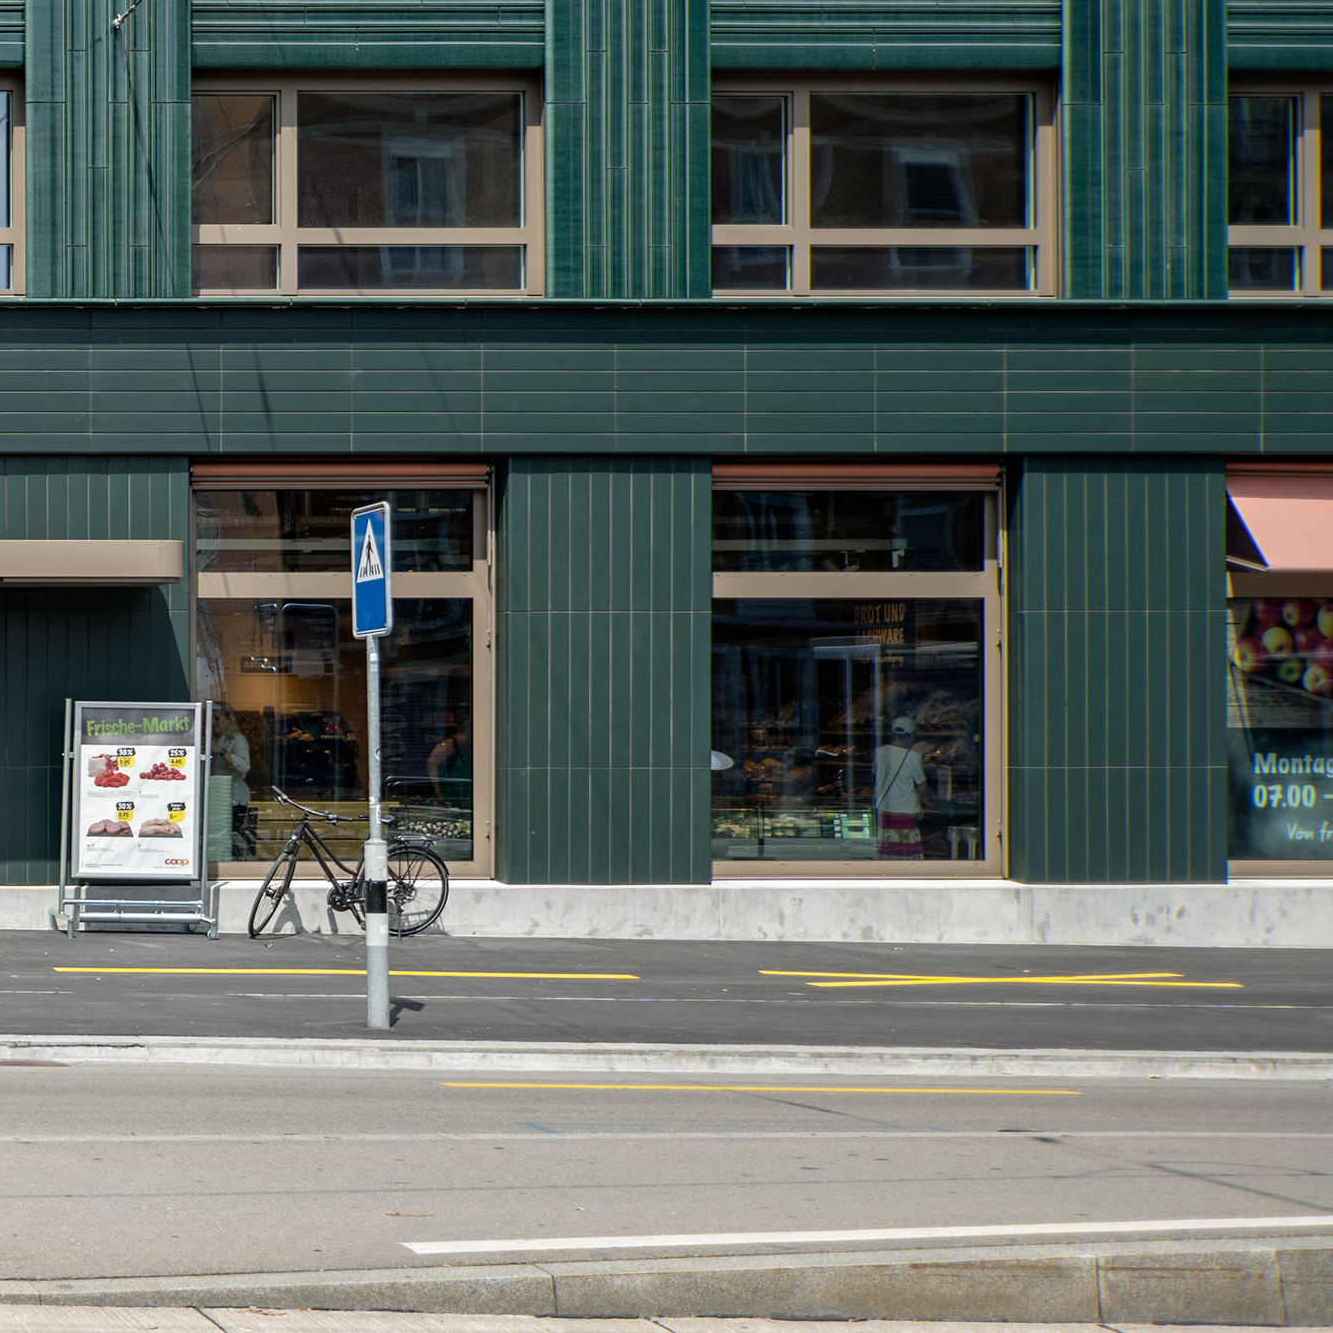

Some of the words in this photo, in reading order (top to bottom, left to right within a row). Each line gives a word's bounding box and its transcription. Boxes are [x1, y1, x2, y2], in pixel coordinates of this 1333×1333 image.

[854, 604, 881, 624] BROT
[884, 603, 905, 623] UND
[86, 716, 190, 736] Frische-Markt
[1251, 784, 1317, 808] 07.00
[117, 802, 133, 810] 30%
[1285, 822, 1314, 840] Von
[164, 858, 189, 866] coop
